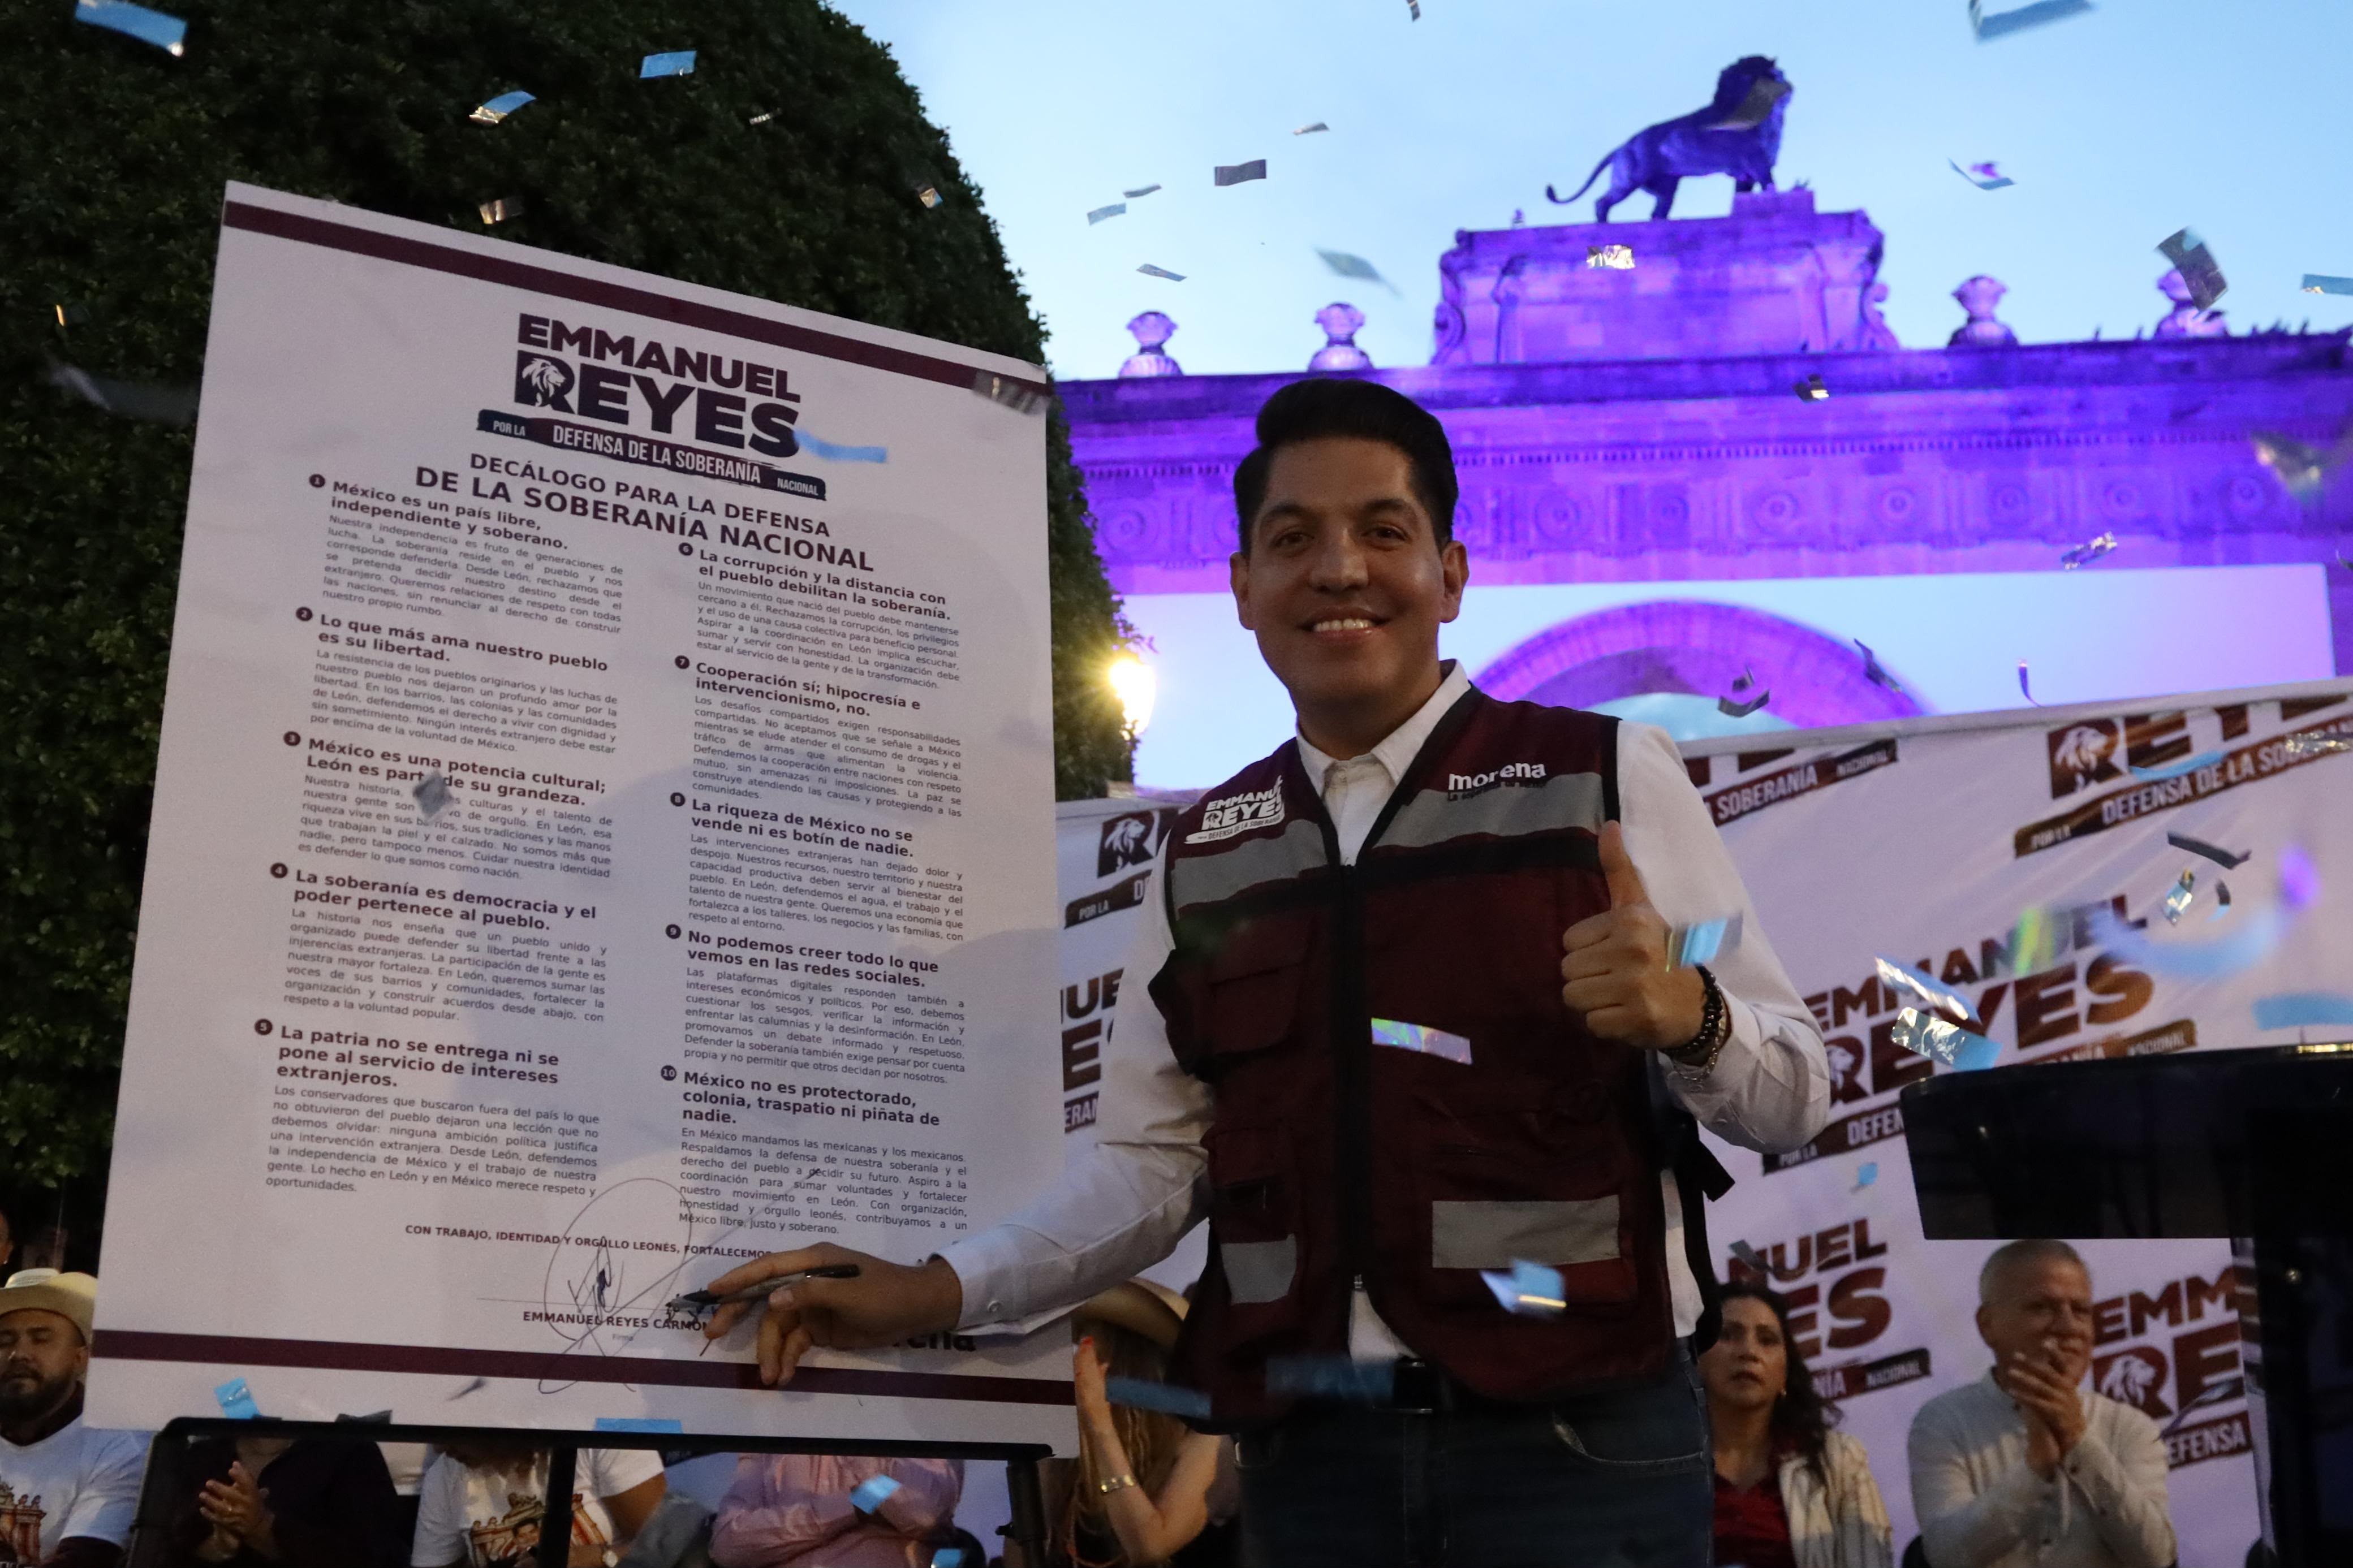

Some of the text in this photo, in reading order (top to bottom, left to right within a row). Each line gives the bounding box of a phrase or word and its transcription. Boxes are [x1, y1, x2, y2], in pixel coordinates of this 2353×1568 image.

[517, 313, 801, 403] EMMANUEL
[514, 349, 800, 458] REYES
[493, 420, 819, 496] POR LA DEFENSA DE LA SOBERANÍA NACIONAL
[333, 480, 541, 532] México es un país libre,
[469, 452, 830, 538] DECÁLOGO PARA LA DEFENSA
[331, 495, 568, 550] independiente y soberano.
[415, 465, 874, 573] DE LA SOBERANÍA NACIONAL
[698, 565, 951, 621] el pueblo debilitan la soberanía.
[700, 548, 946, 606] La corrupción y la distancia con
[318, 632, 451, 662] es su libertad.
[320, 613, 609, 672] Lo que más ama nuestro pueblo
[695, 676, 870, 717] intervencionismo, no.
[696, 662, 921, 711] Cooperación sí; hipocresía e
[306, 754, 586, 806] León es part de su grandeza.
[308, 737, 606, 794] México es una potencia cultural;
[1448, 763, 1546, 791] morena
[1717, 763, 1818, 820] SOBERANÍA
[2101, 774, 2193, 824] DEFENSA
[2196, 766, 2225, 791] DE
[2227, 754, 2254, 781] LA
[691, 817, 913, 858] vende ni es botín de nadie.
[692, 798, 913, 842] La riqueza de México no se
[293, 889, 550, 931] poder pertenece al pueblo.
[295, 869, 597, 919] La soberanía es democracia y el
[1098, 900, 1109, 913] LA
[687, 949, 925, 988] vemos en las redes sociales.
[688, 930, 939, 973] No podemos creer todo lo que
[278, 1046, 559, 1085] pone al servicio de intereses
[280, 1025, 559, 1066] La patria no se entrega ni se
[276, 1065, 398, 1087] extranjeros.
[683, 1070, 917, 1109] México no es protectorado,
[682, 1090, 941, 1126] colonia, traspatio ni piñata de
[682, 1108, 736, 1124] nadie.
[1847, 1107, 1904, 1146] DEFE
[404, 1224, 771, 1259] CON TRABAJO, IDENTIDAD Y ORGULLO LEONÉS, FORTALECEMO
[523, 1311, 602, 1326] EMMANUEL
[606, 1316, 649, 1328] REYES
[2169, 1419, 2247, 1466] EFENSA
